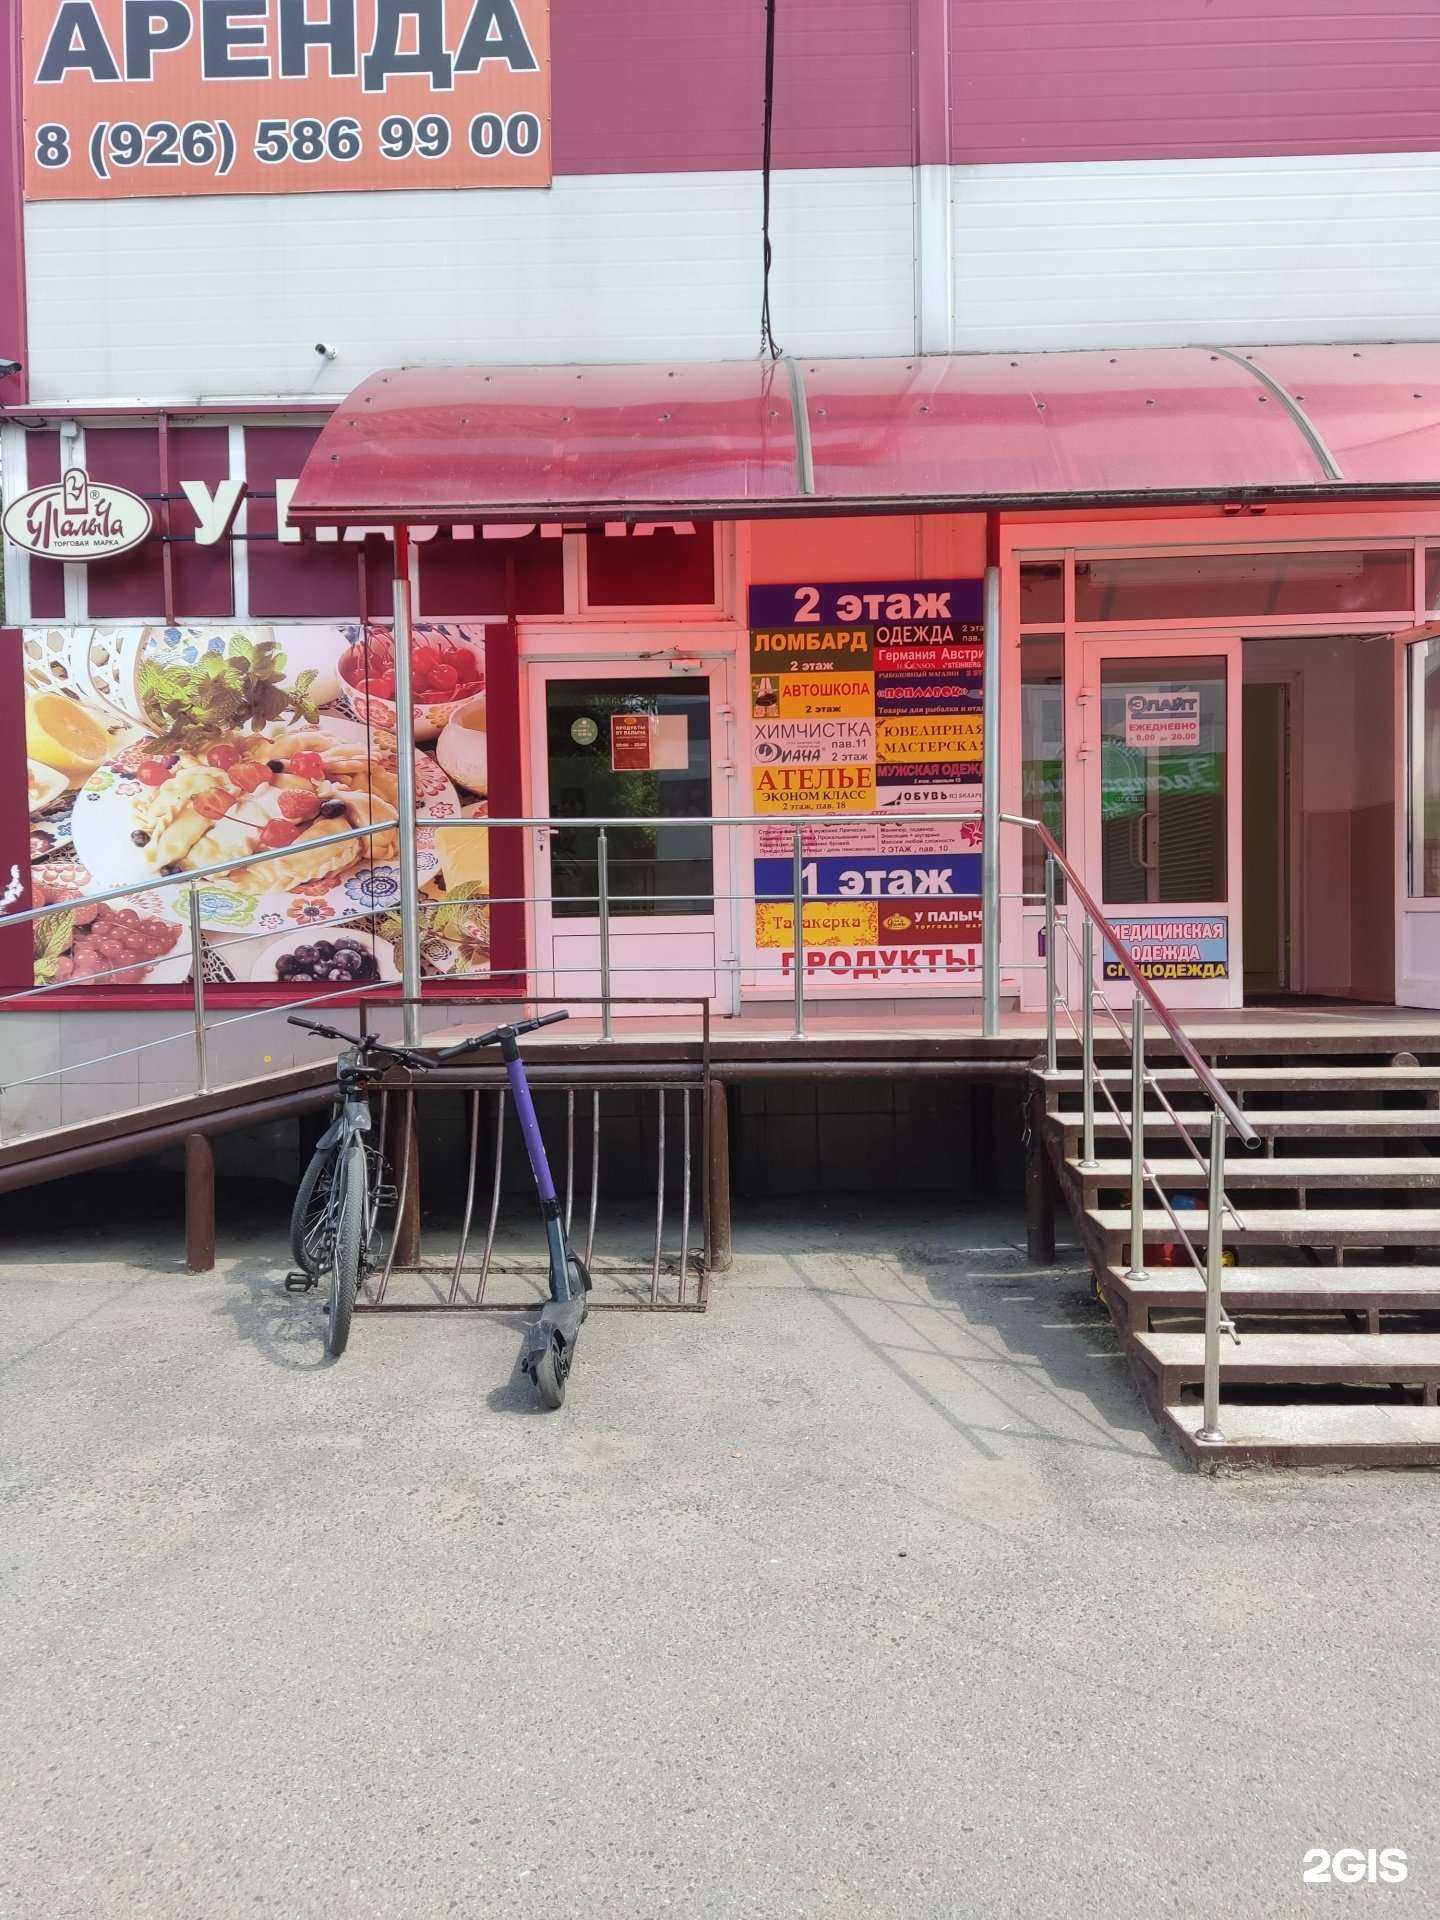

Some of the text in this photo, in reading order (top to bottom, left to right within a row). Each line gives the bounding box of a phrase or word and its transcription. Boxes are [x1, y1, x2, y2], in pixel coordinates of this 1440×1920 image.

[34, 0, 540, 93] АРЕНДА
[34, 112, 542, 179] 8 (926) 586 99 00
[178, 480, 249, 545] У
[93, 538, 119, 546] МАРКА
[794, 587, 952, 622] 2 этаж
[754, 631, 868, 652] ЛОМБАРД
[876, 625, 954, 646] ОДЕЖДА
[879, 647, 984, 663] Германия Австри
[790, 660, 834, 671] 2 этаж
[782, 682, 870, 698] АВТОШКОЛА
[815, 705, 841, 713] этаж
[879, 706, 907, 715] Товары
[911, 706, 923, 714] для
[1128, 696, 1197, 712] ЭЛАЙТ
[755, 722, 872, 739] ХИМЧИСТКА
[1129, 722, 1197, 732] ЕЖЕДНЕВНО
[832, 752, 868, 761] 2 этаж
[878, 764, 940, 776] МУЖСКАЯ
[756, 768, 872, 790] АТЕЛЬЕ
[763, 790, 866, 801] ЭКОНОМ КЛАСС
[904, 792, 948, 800] ОБУВЬ
[801, 862, 953, 896] 1 этаж
[772, 915, 861, 931] Таакерка
[914, 911, 983, 922] У ПАЛЫЧ
[1131, 944, 1201, 962] ОДЕЖДА
[1107, 963, 1226, 979] СПЦОДЕЖДА
